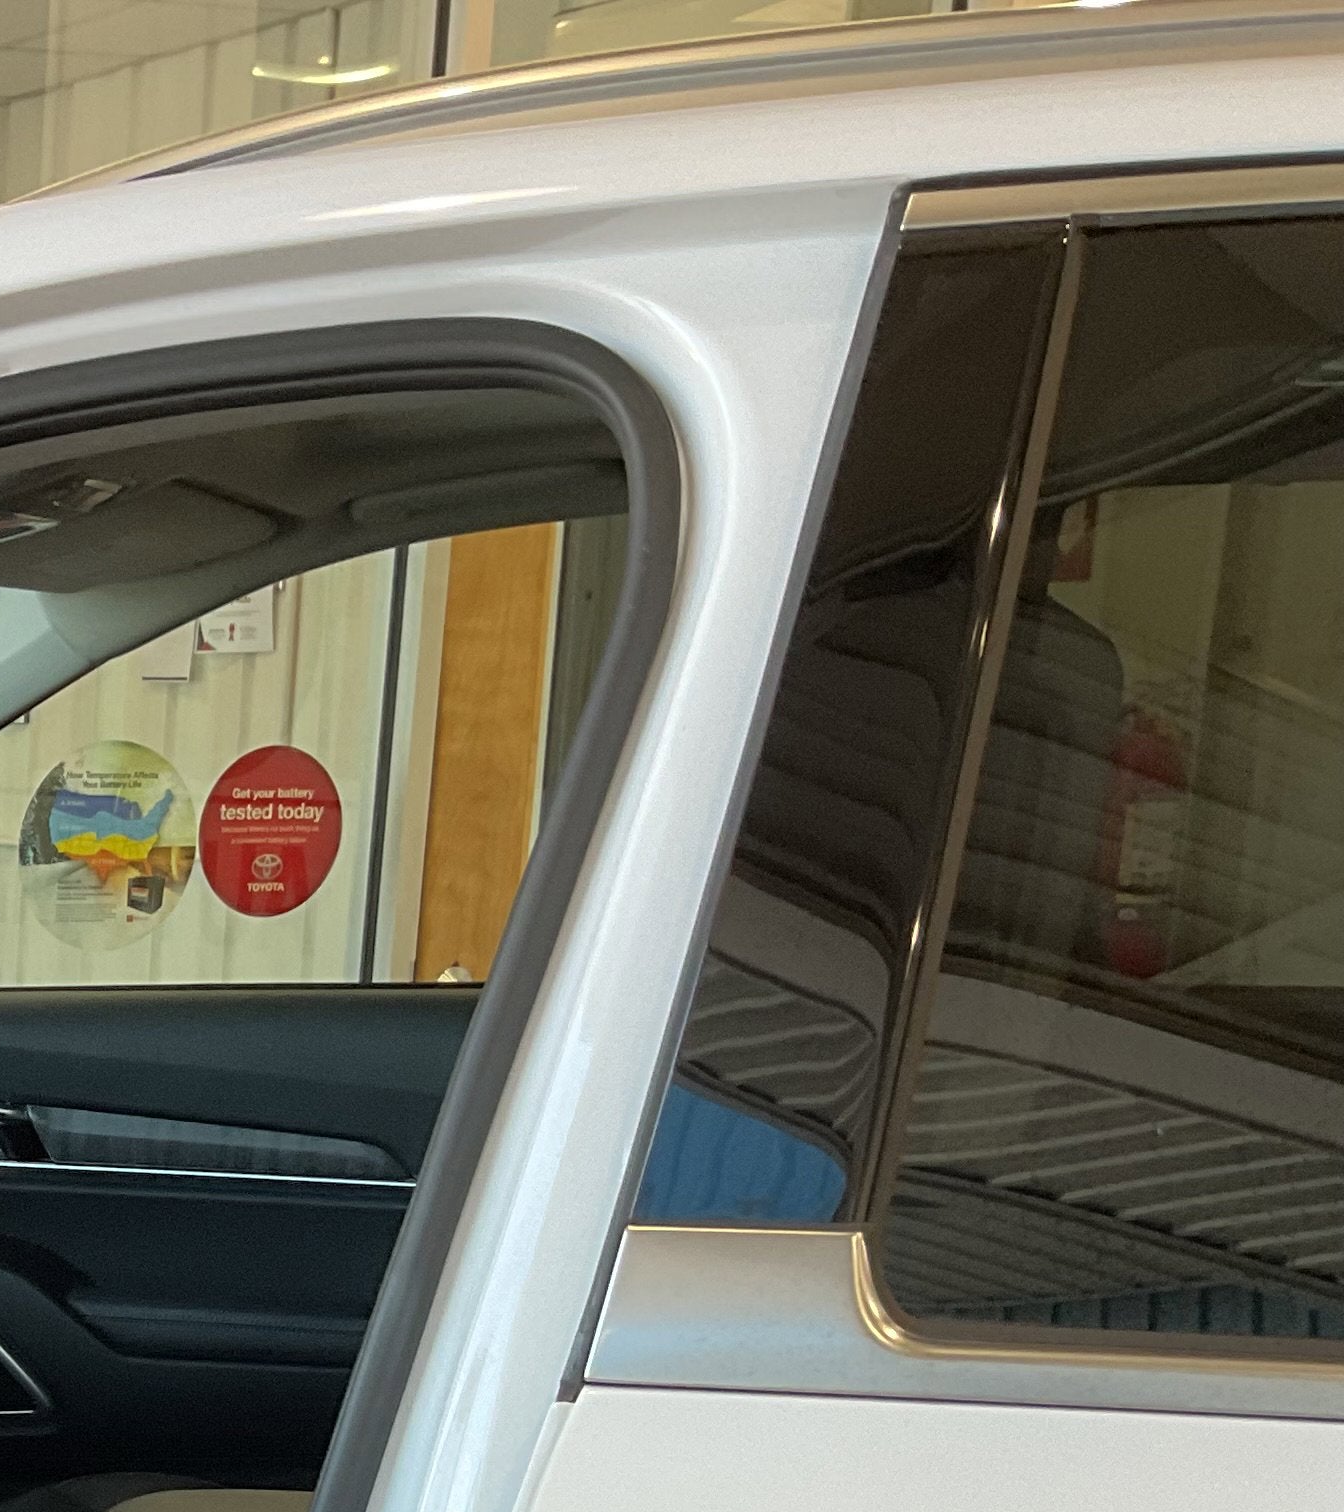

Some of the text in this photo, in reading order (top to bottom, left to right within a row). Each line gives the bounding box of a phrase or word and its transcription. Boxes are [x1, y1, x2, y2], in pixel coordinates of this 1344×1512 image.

[231, 787, 315, 801] Get your battery
[219, 802, 325, 823] tested today
[246, 882, 286, 893] TOYOTA
